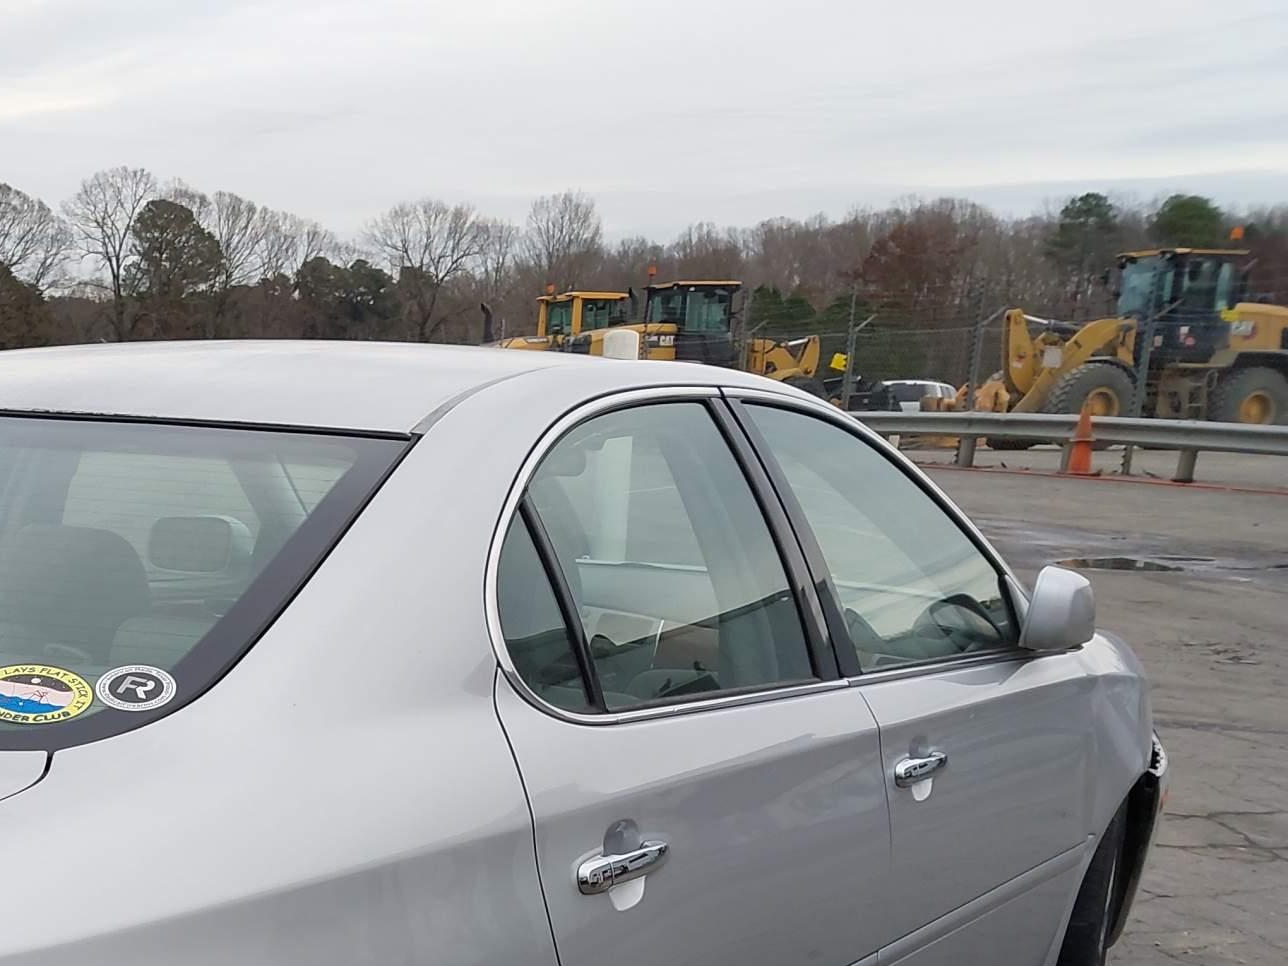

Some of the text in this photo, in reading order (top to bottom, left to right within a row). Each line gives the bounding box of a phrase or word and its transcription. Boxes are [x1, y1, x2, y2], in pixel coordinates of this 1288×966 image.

[3, 667, 37, 675] LAYS
[39, 668, 69, 680] FLAT
[68, 675, 89, 699] STICK
[73, 699, 86, 710] IT
[32, 710, 71, 722] CLUB
